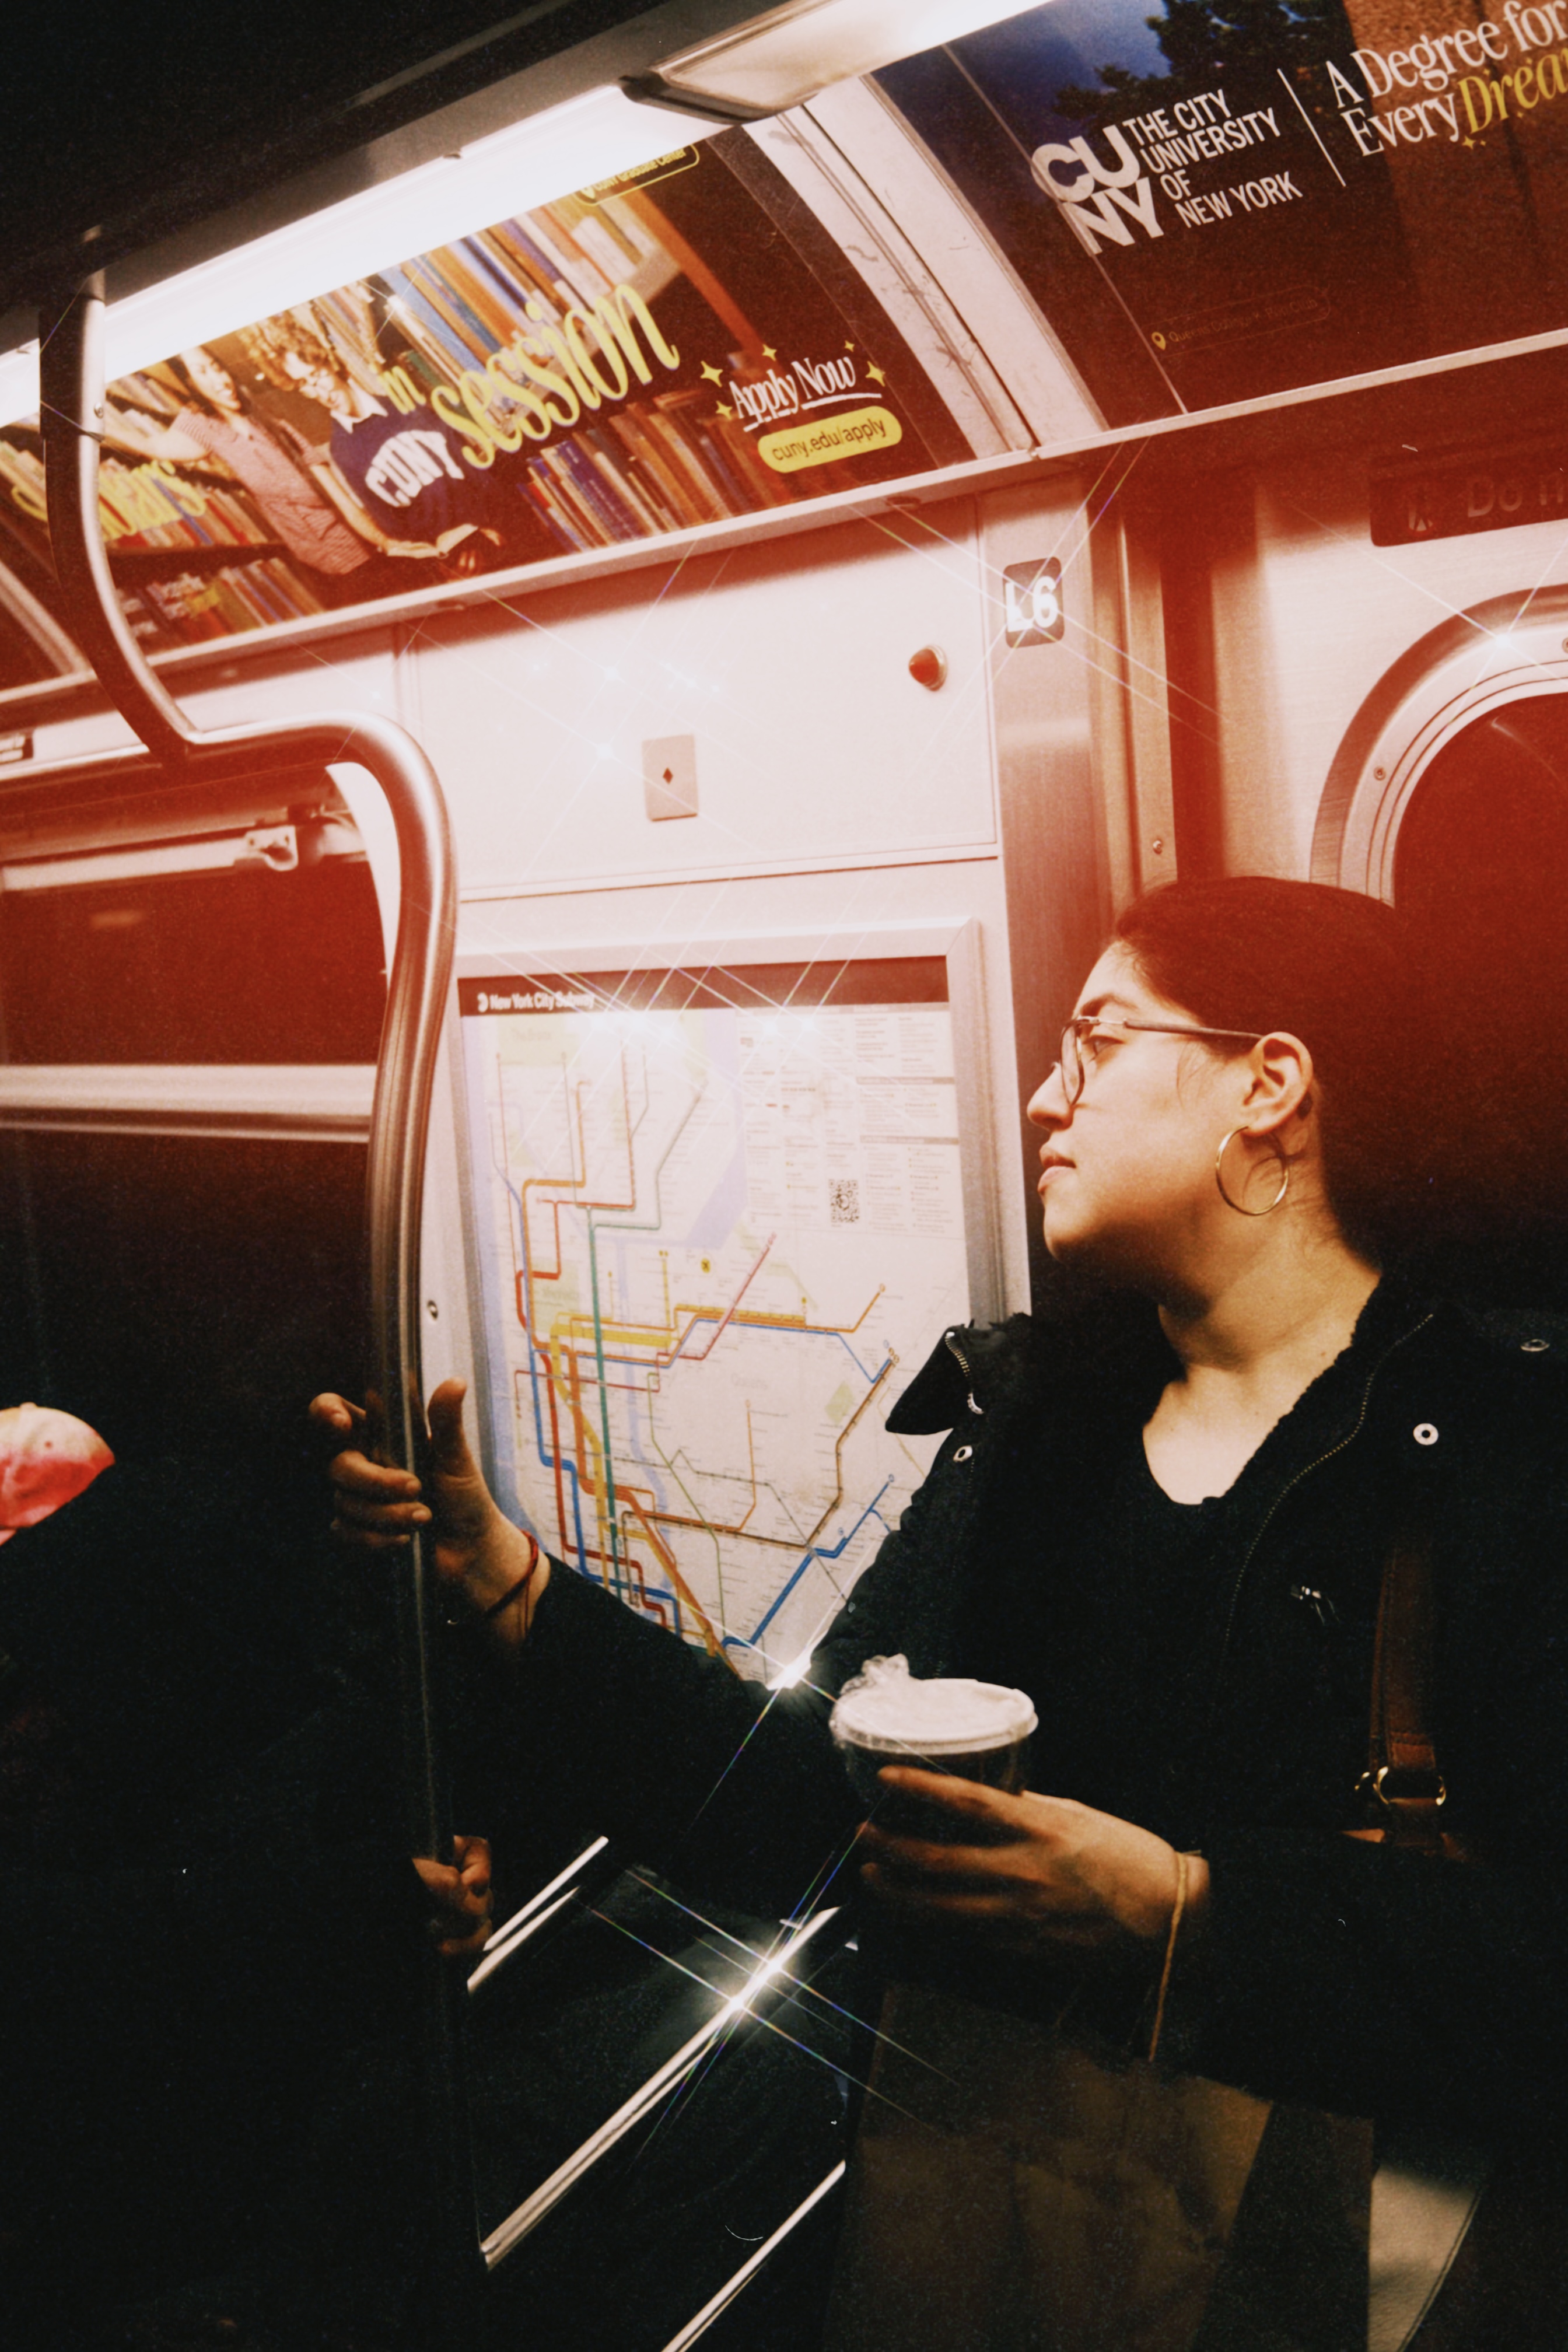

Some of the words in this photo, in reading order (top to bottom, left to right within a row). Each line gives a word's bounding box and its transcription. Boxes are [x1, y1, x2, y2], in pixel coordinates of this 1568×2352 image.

[1325, 60, 1364, 109] A
[1349, 21, 1508, 98] Degree
[1503, 0, 1568, 52] for
[1122, 108, 1178, 146] THE
[1173, 88, 1232, 131] CITY
[1340, 93, 1460, 157] Every
[1457, 47, 1568, 134] Drea
[1139, 107, 1281, 174] UNIVERSITY
[1160, 169, 1192, 201] OF
[1174, 190, 1233, 229] NEW
[1228, 171, 1303, 213] YORK
[430, 284, 681, 469] session
[729, 369, 800, 424] Apply
[790, 356, 856, 400] Now
[365, 429, 465, 508] CUNY
[772, 418, 887, 461] cuny.edu/apply
[1005, 575, 1059, 633] L6
[489, 993, 512, 1010] New
[512, 992, 534, 1009] York
[533, 992, 555, 1011] City
[555, 991, 595, 1010] Subway
